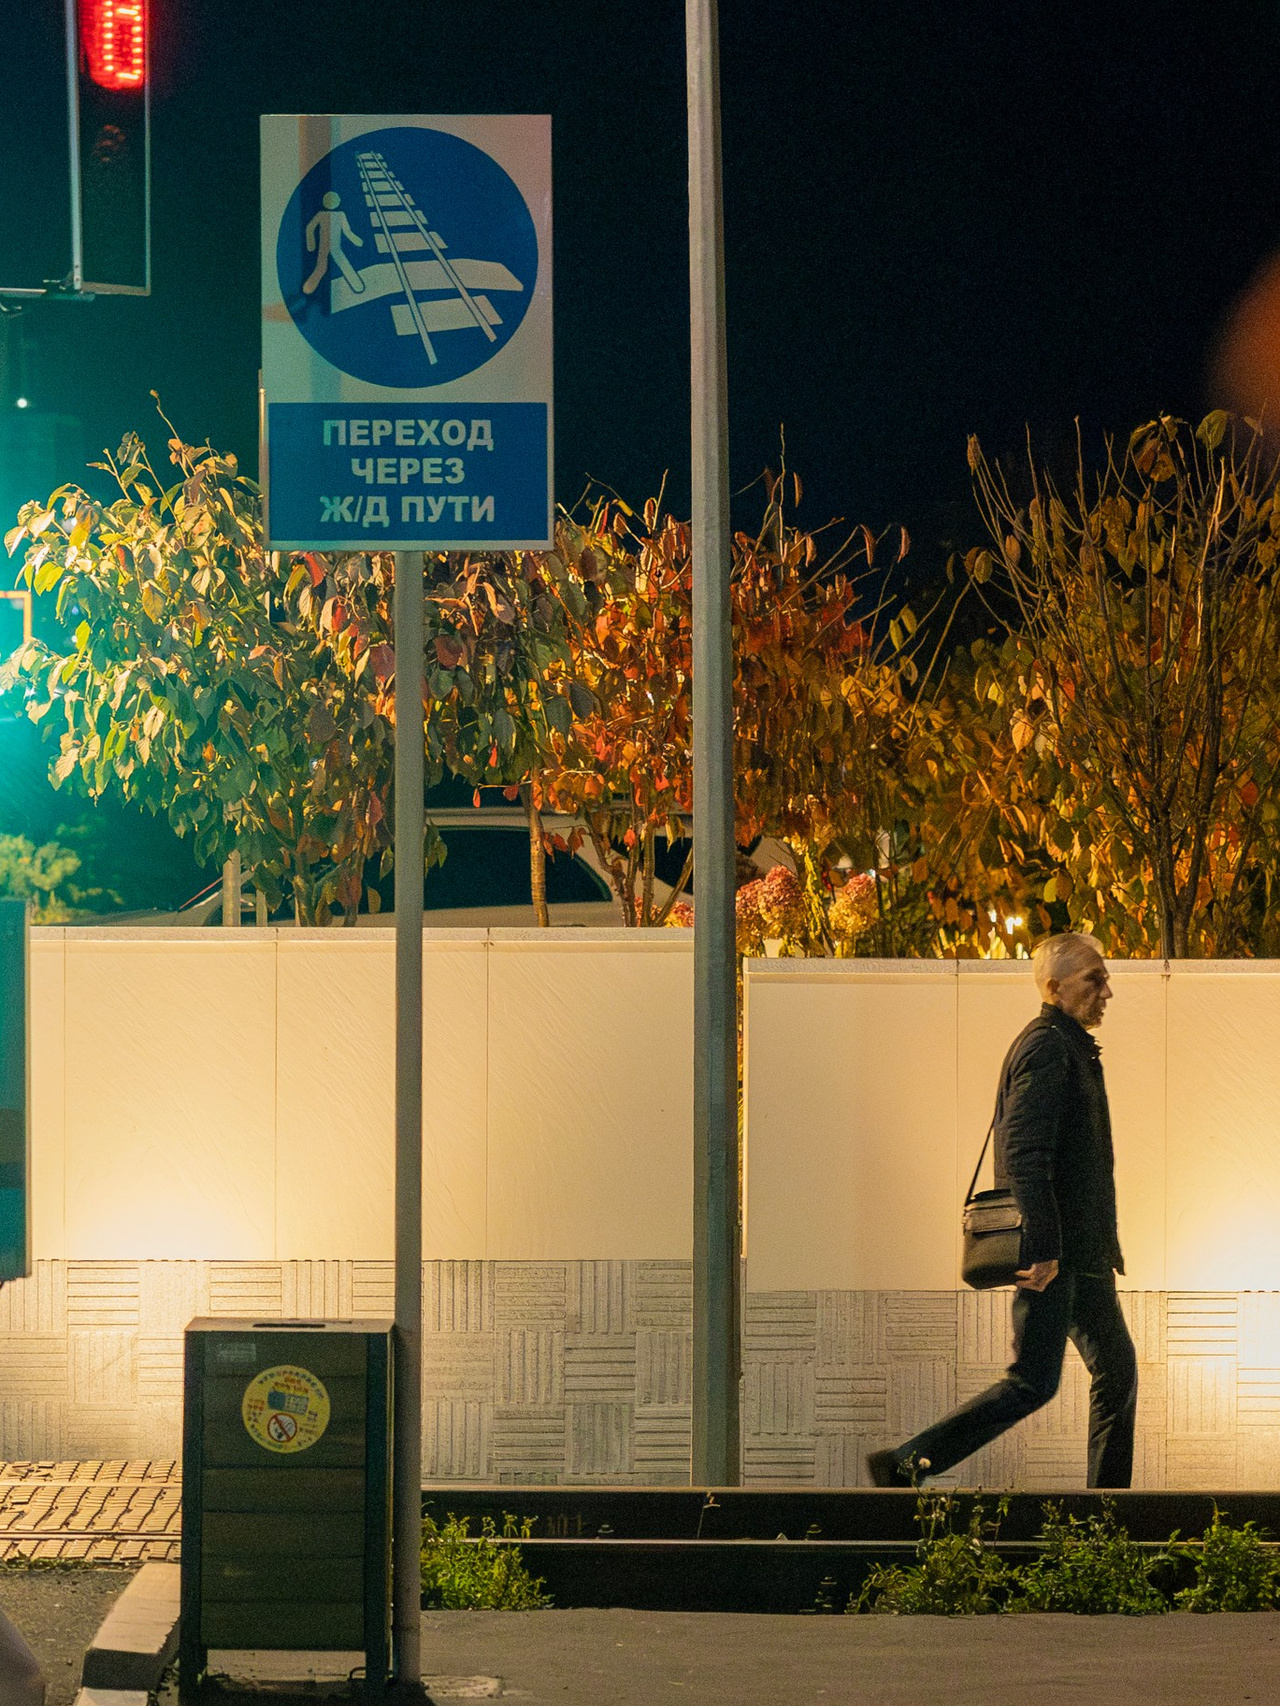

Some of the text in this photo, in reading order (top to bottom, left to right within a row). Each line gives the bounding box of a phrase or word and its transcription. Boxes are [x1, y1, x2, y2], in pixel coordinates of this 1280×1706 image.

[322, 419, 494, 451] ПЕРЕХОД
[351, 457, 466, 484] ЧЕРЕЗ
[320, 495, 495, 527] Ж/Д ПУТИ
